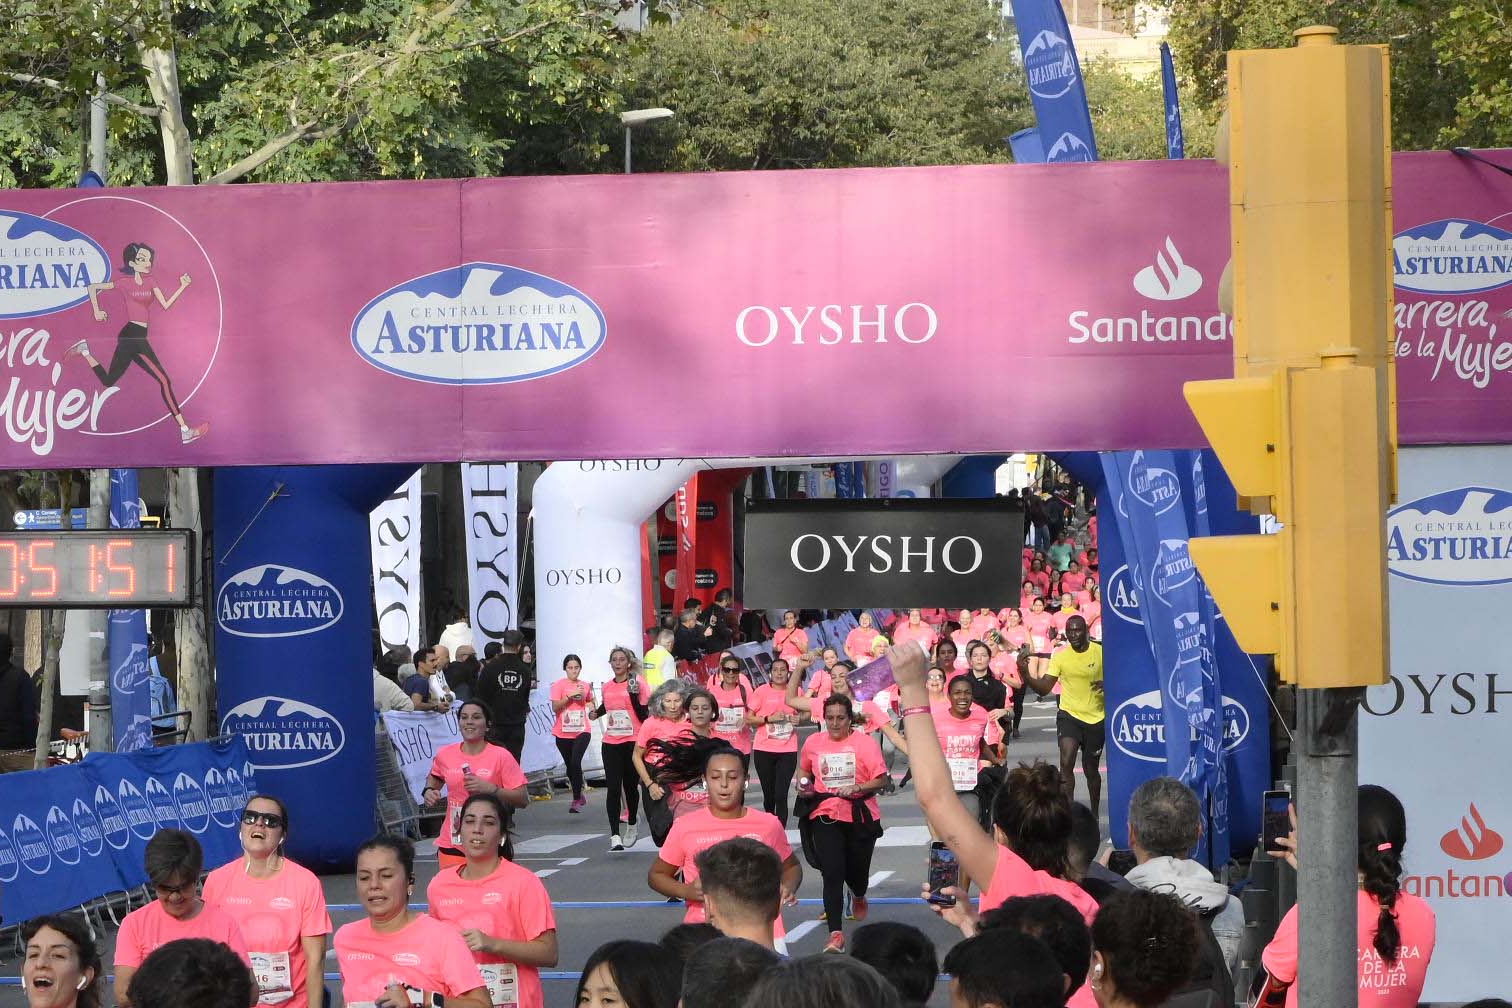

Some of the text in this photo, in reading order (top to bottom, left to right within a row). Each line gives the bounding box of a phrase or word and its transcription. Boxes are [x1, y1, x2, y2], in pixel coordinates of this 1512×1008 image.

[15, 247, 86, 258] LECHERA
[1408, 245, 1458, 254] CENTRAL
[410, 303, 578, 319] CENTRAL LECHERA
[371, 309, 587, 355] ASTURIANA
[735, 302, 938, 347] OYSHO
[1417, 330, 1436, 358] la
[789, 533, 984, 575] OYSHO
[546, 568, 622, 587] OYSHO
[234, 589, 329, 598] CENTRAL LECHERA
[221, 594, 334, 621] ASTURIANA
[504, 675, 517, 684] BP
[235, 721, 330, 730] CENTRAL LECHERA
[1364, 961, 1383, 975] DE
[1359, 974, 1408, 988] MUJER
